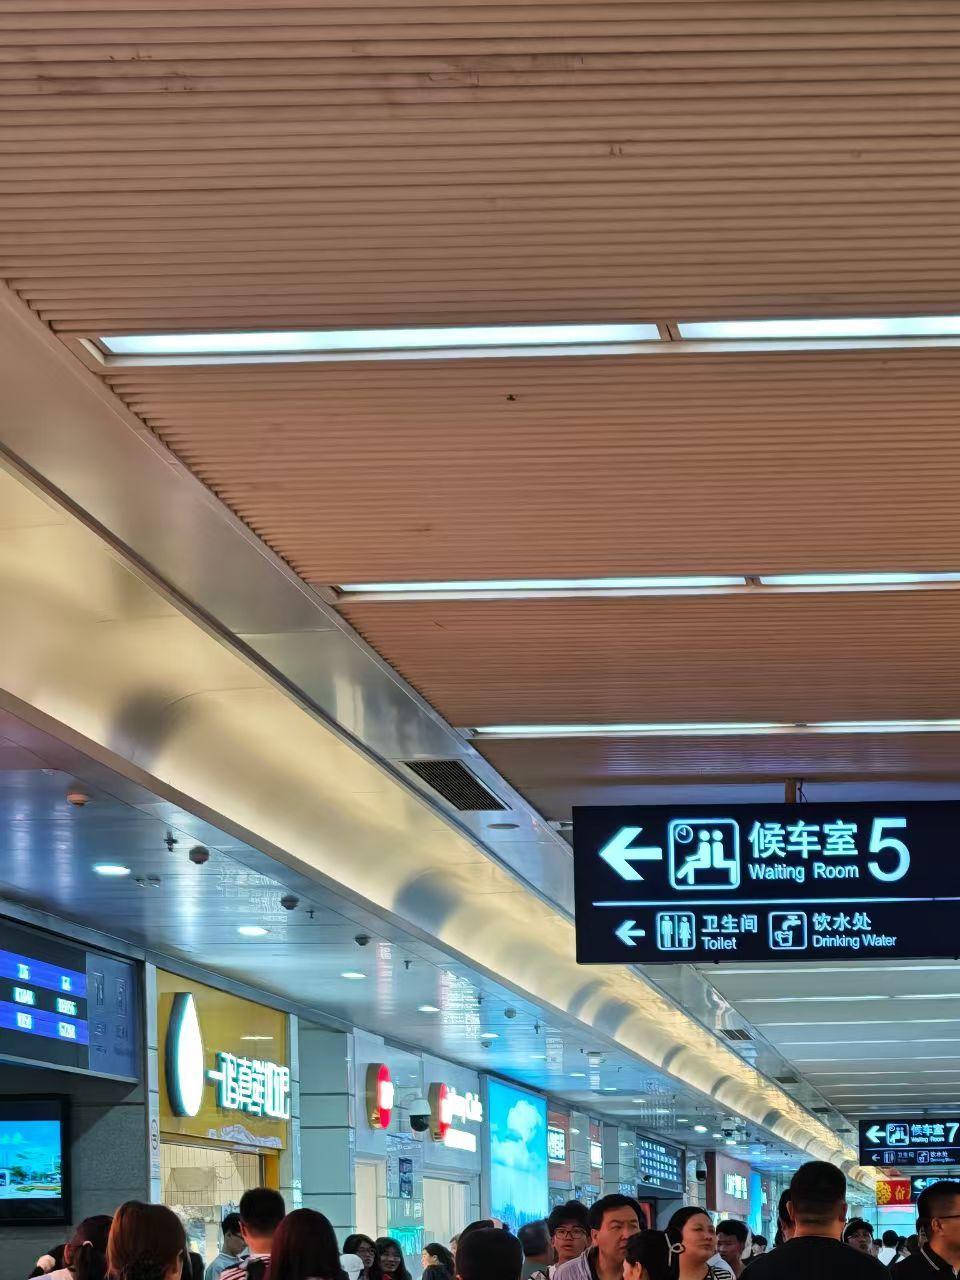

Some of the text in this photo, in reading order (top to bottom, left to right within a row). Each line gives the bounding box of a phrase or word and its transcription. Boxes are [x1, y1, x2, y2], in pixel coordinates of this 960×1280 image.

[748, 817, 911, 882] 候车室 5
[747, 861, 860, 883] Waiting Room
[701, 913, 758, 934] 卫生间
[811, 912, 872, 932] 饮水处
[700, 936, 737, 950] Toilet
[811, 933, 898, 950] Drinking Water
[910, 1122, 960, 1143] 候车室 7
